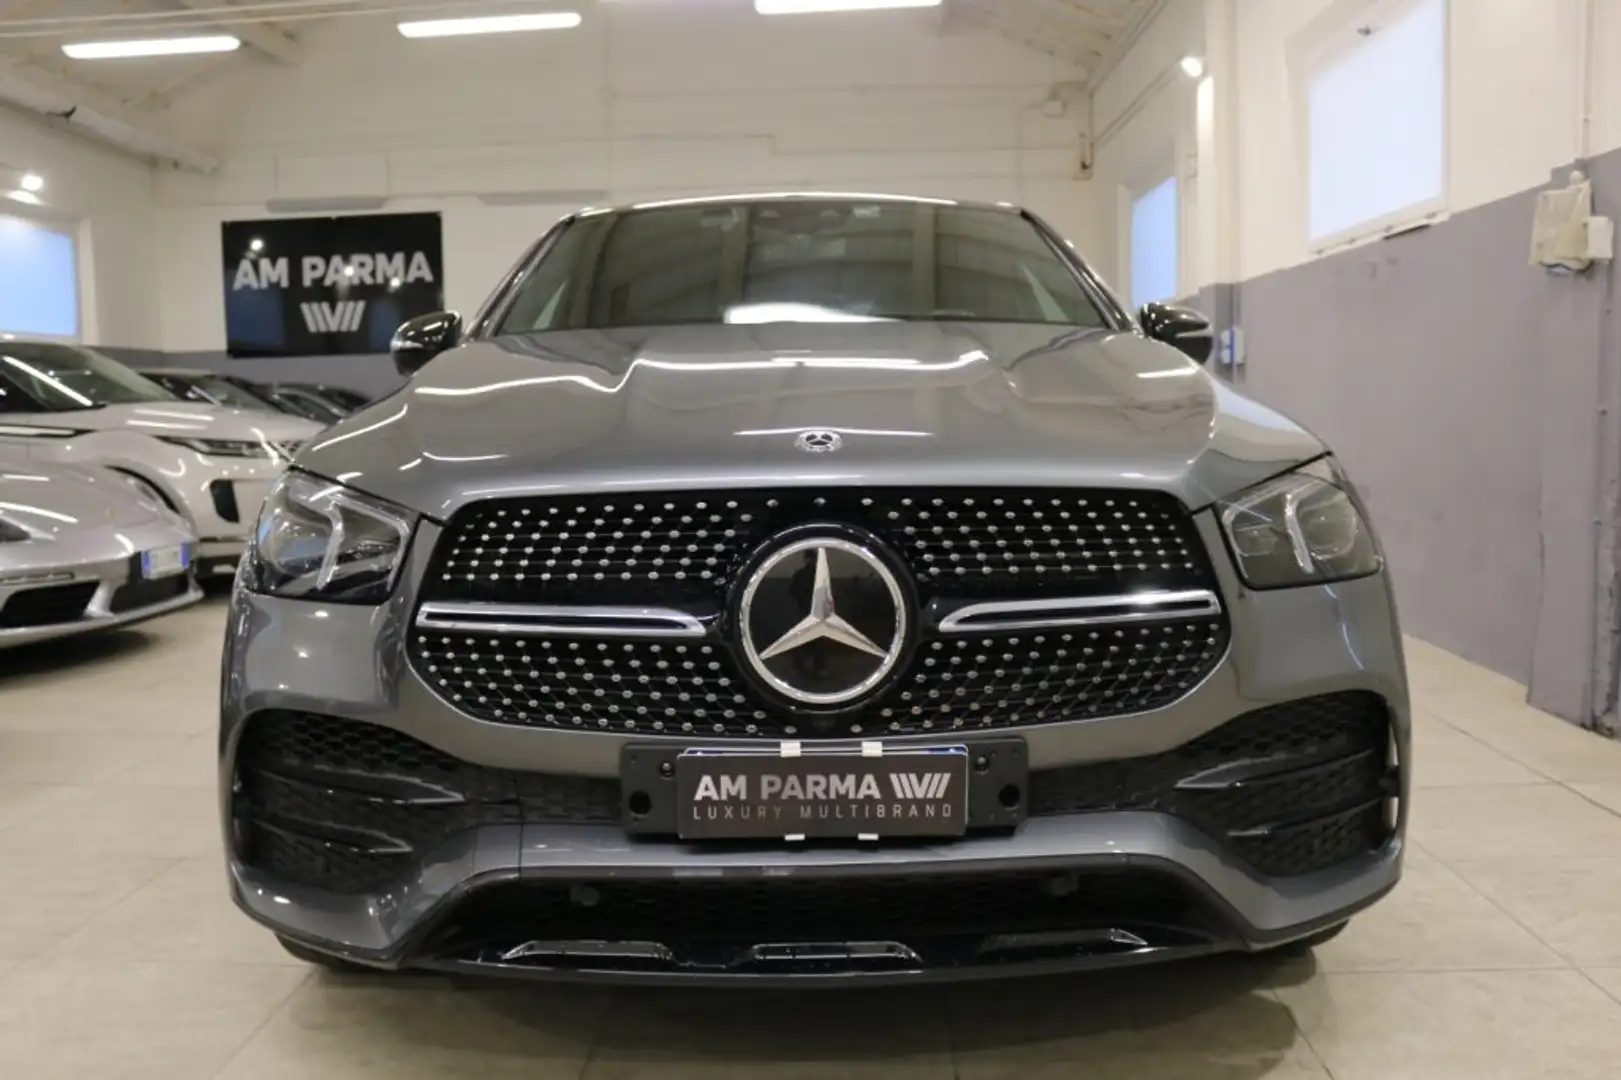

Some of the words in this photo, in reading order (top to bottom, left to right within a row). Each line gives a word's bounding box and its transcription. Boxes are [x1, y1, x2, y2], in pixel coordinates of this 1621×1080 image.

[232, 257, 289, 290] AM
[301, 251, 434, 287] PARMA
[693, 774, 747, 800] AM
[760, 773, 882, 800] PARMA
[693, 804, 782, 820] LUXURY
[799, 803, 952, 819] MULTIBRAND
